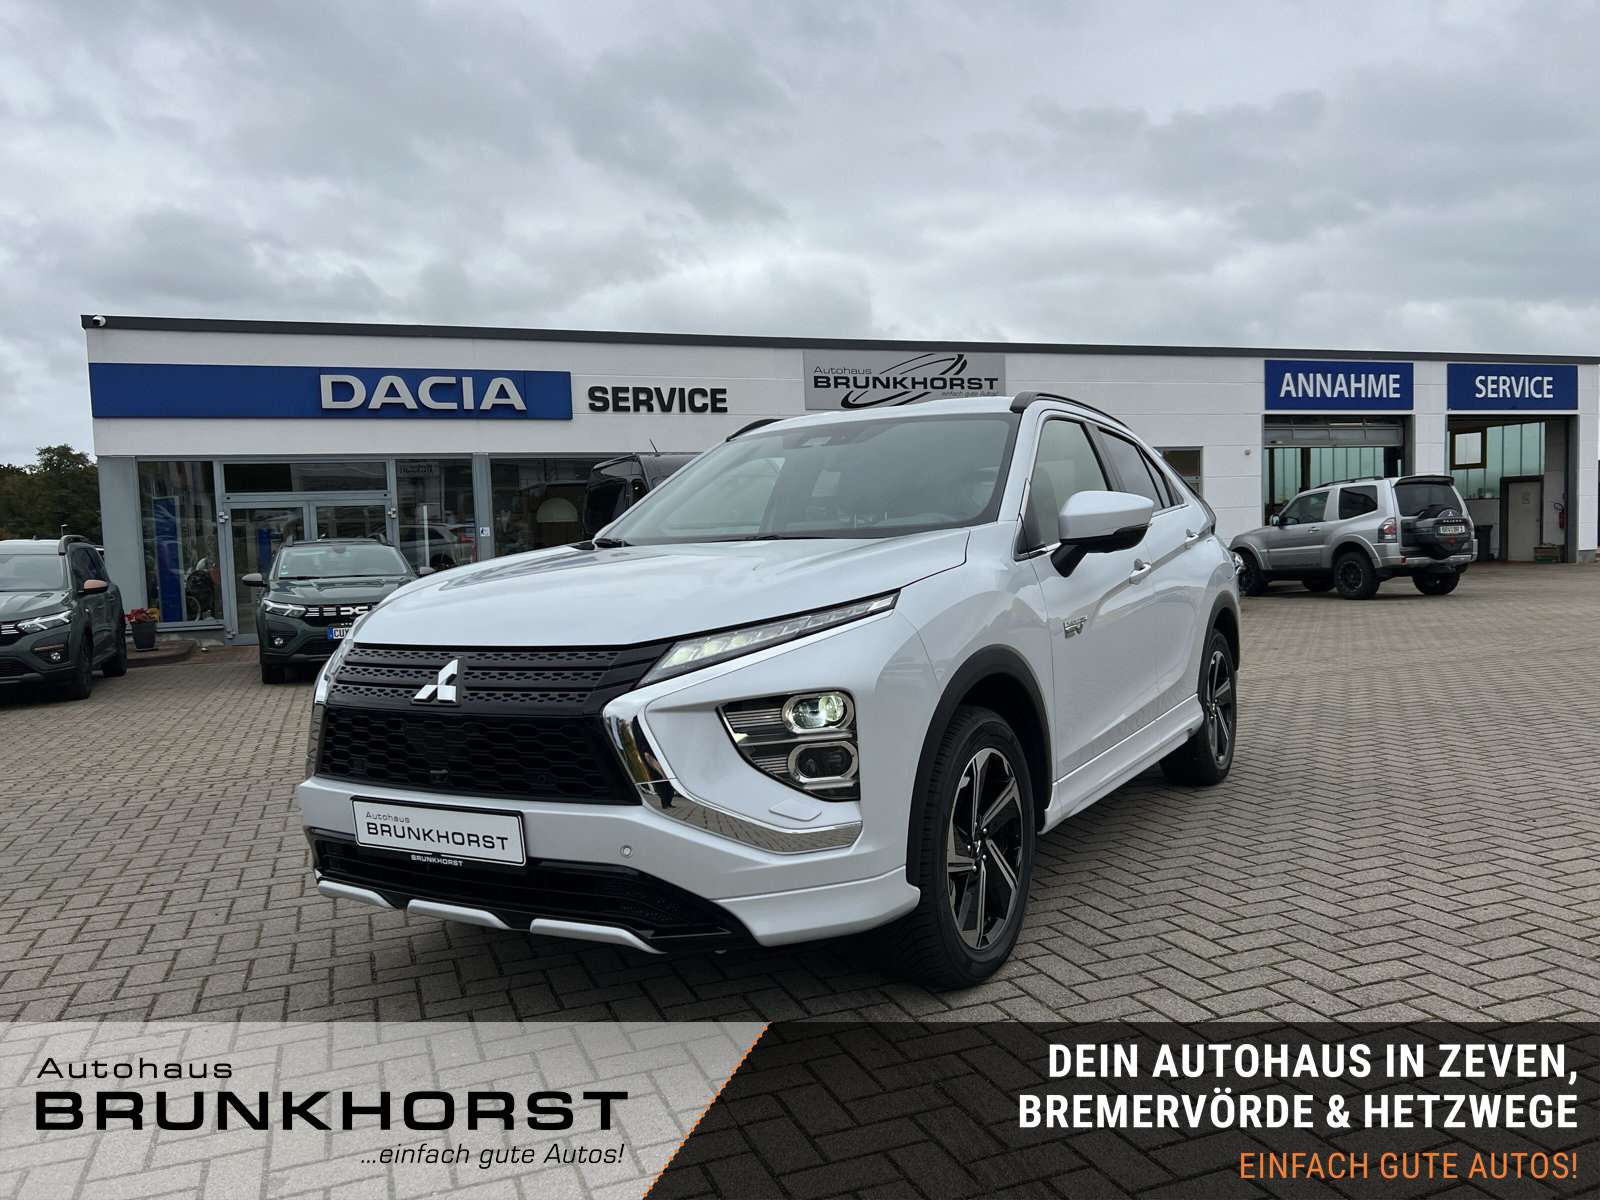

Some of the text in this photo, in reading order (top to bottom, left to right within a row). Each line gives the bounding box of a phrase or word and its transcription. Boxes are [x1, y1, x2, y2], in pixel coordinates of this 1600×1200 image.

[814, 366, 872, 375] Autohaus
[319, 374, 528, 411] DACIA
[814, 376, 999, 390] BRUNKHORST
[1280, 372, 1401, 398] ANNAHME
[1475, 375, 1554, 399] SERVICE
[587, 385, 728, 414] SERVICE
[365, 811, 410, 824] Autohaus
[366, 821, 508, 851] BRUNKHORST
[410, 854, 463, 867] BRUNKHORST
